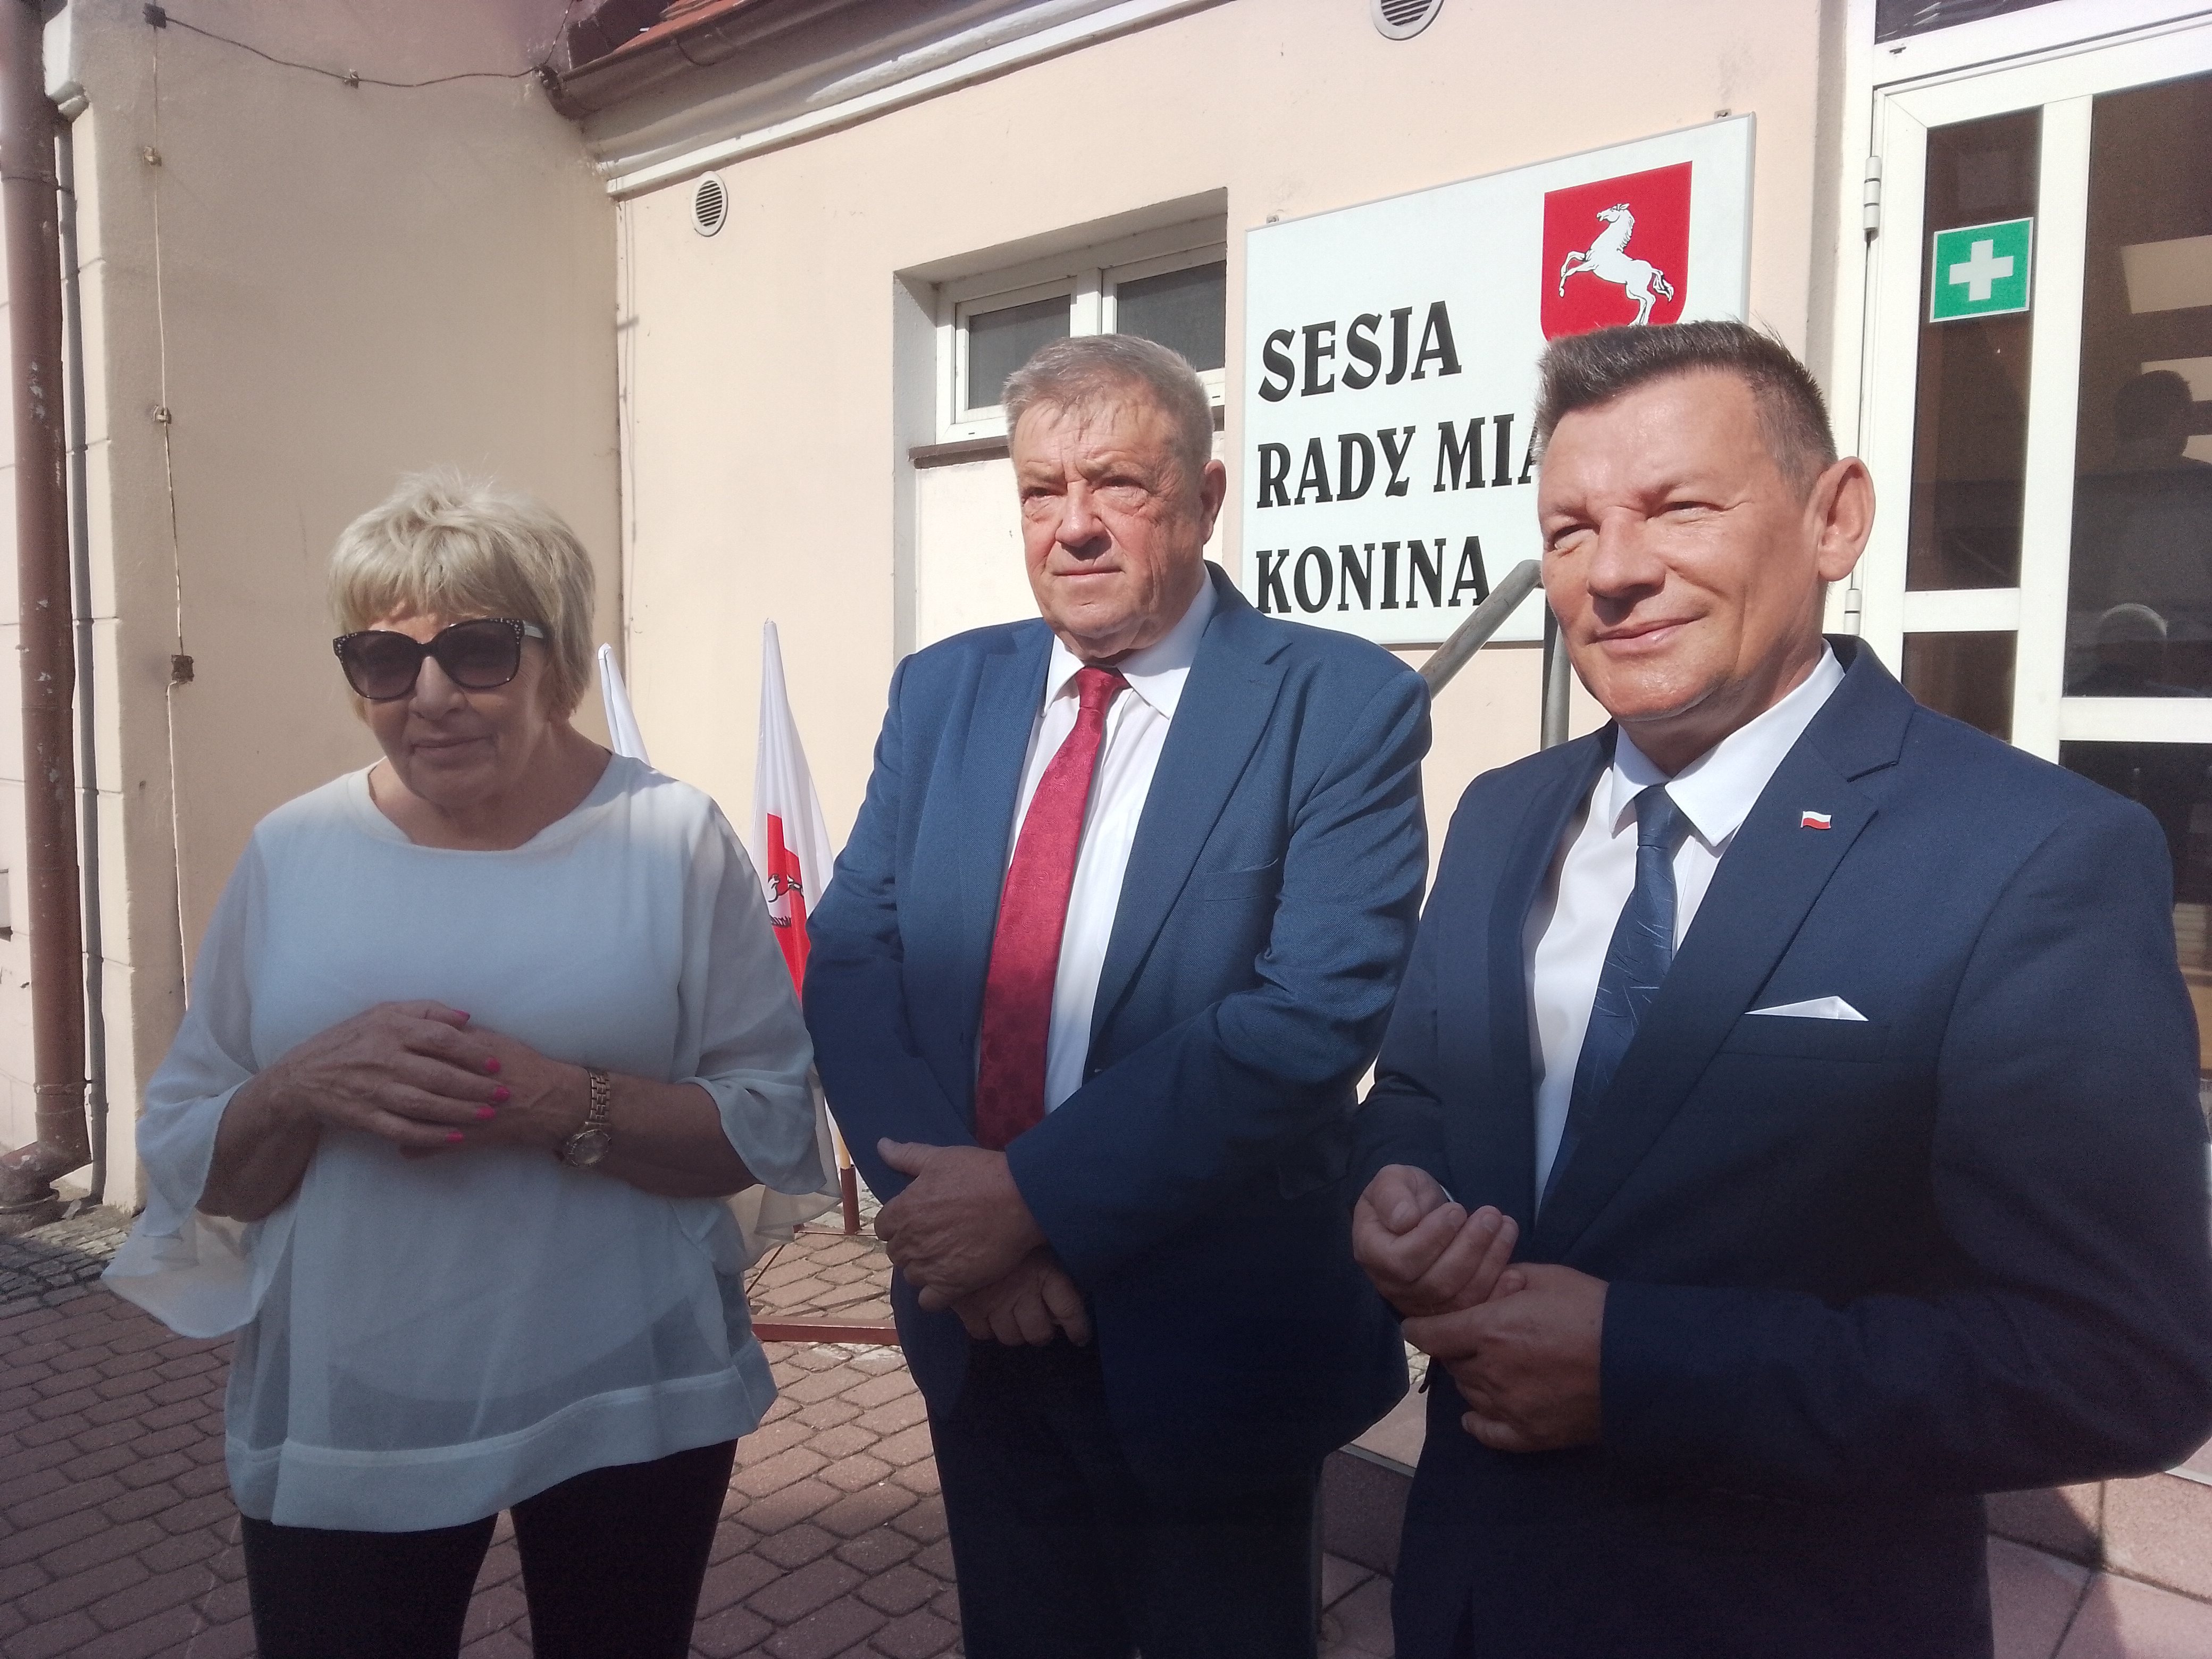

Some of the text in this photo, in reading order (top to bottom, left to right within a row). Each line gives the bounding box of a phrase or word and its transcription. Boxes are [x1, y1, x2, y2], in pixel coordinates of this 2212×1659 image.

[1258, 300, 1462, 403] SESJA
[1256, 425, 1416, 509] RADY
[1256, 535, 1490, 614] KONINA
